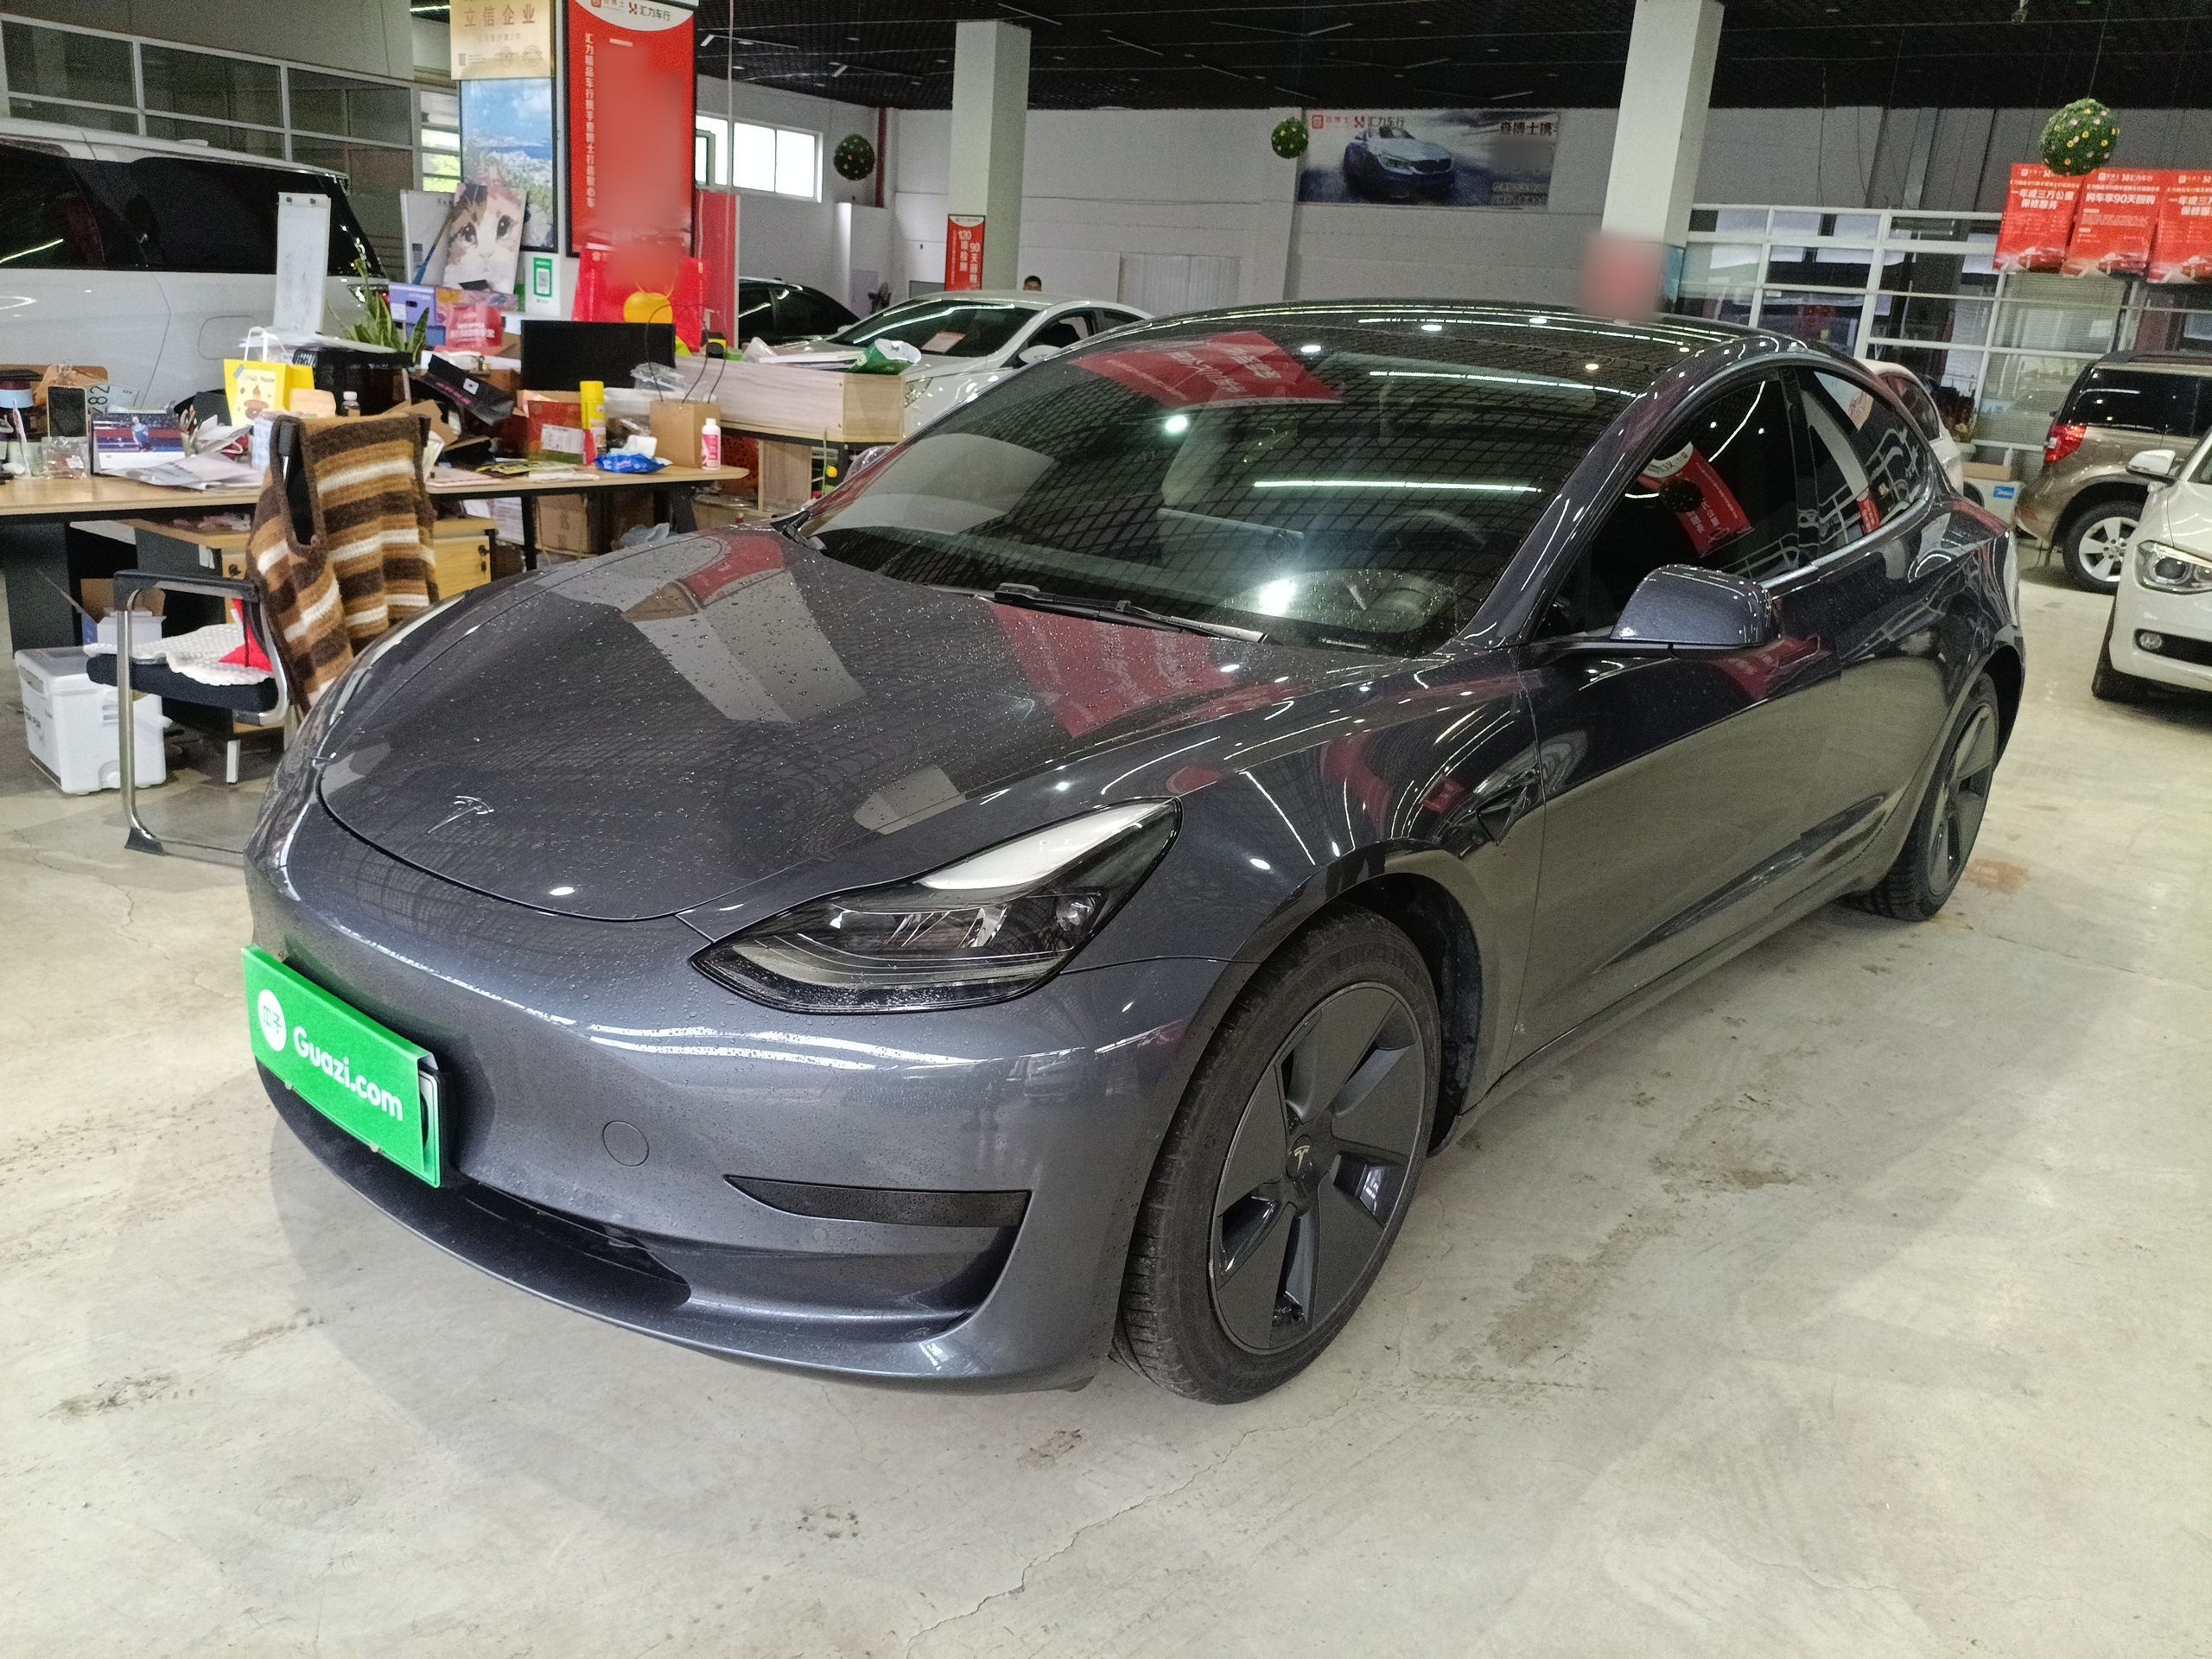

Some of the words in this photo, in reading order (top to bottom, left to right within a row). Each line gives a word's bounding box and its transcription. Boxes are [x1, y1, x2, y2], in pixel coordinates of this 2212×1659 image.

[463, 3, 536, 28] 立信企业
[639, 5, 671, 22] 汇力车行
[293, 1026, 404, 1122] Guazi.com
